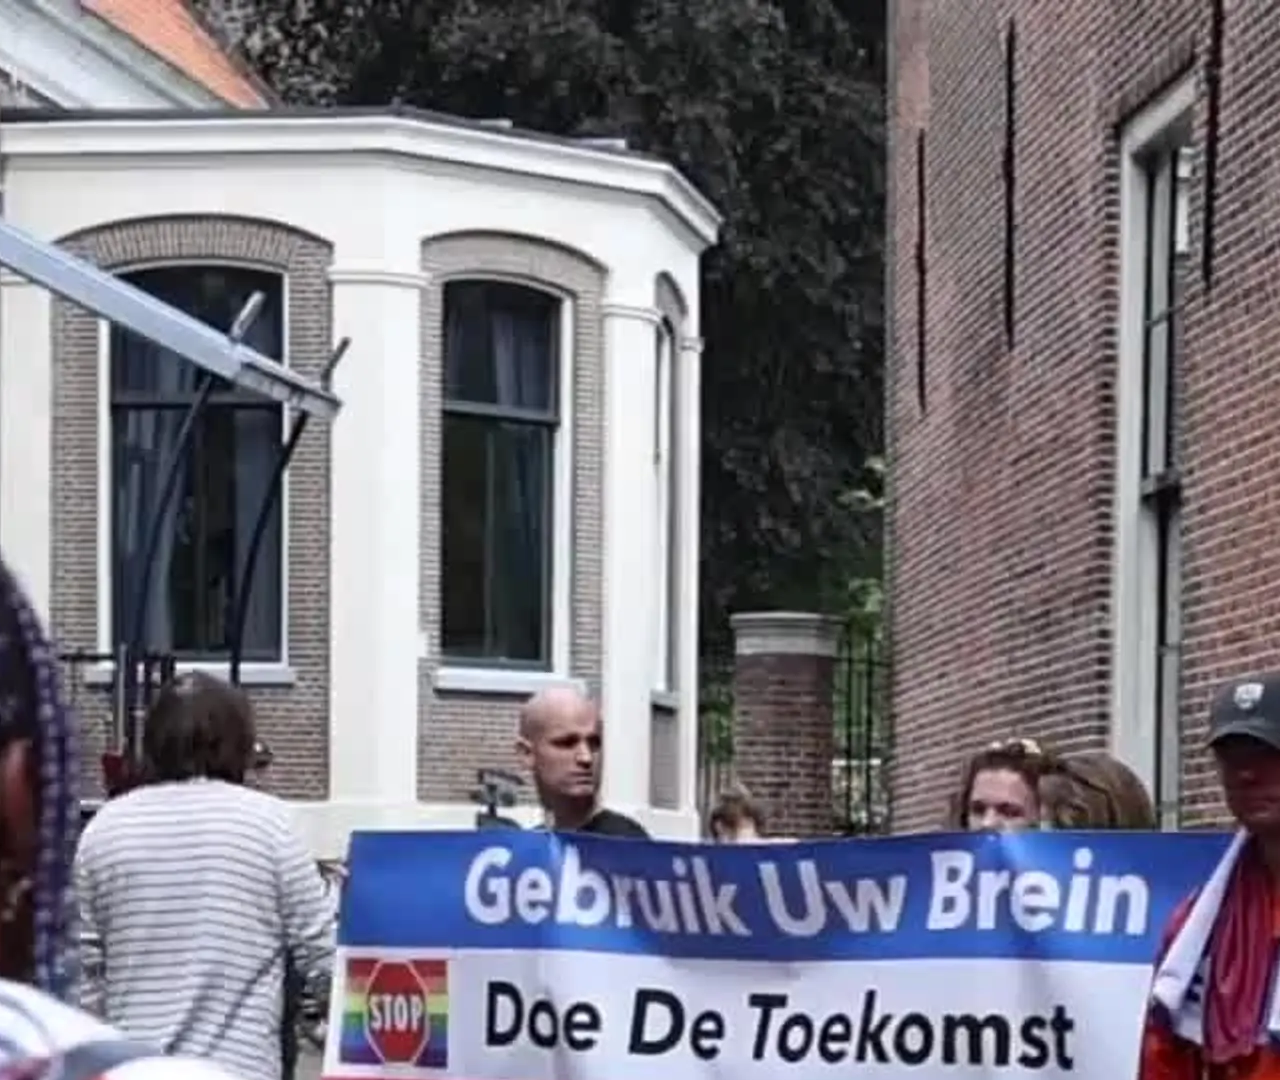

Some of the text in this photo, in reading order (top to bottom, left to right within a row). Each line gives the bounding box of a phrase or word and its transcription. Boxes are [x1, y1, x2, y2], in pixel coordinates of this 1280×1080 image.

[464, 847, 1150, 938] Gebruik Uw Brein
[369, 993, 423, 1032] STOP
[486, 981, 1075, 1070] Doe De Toekomst
